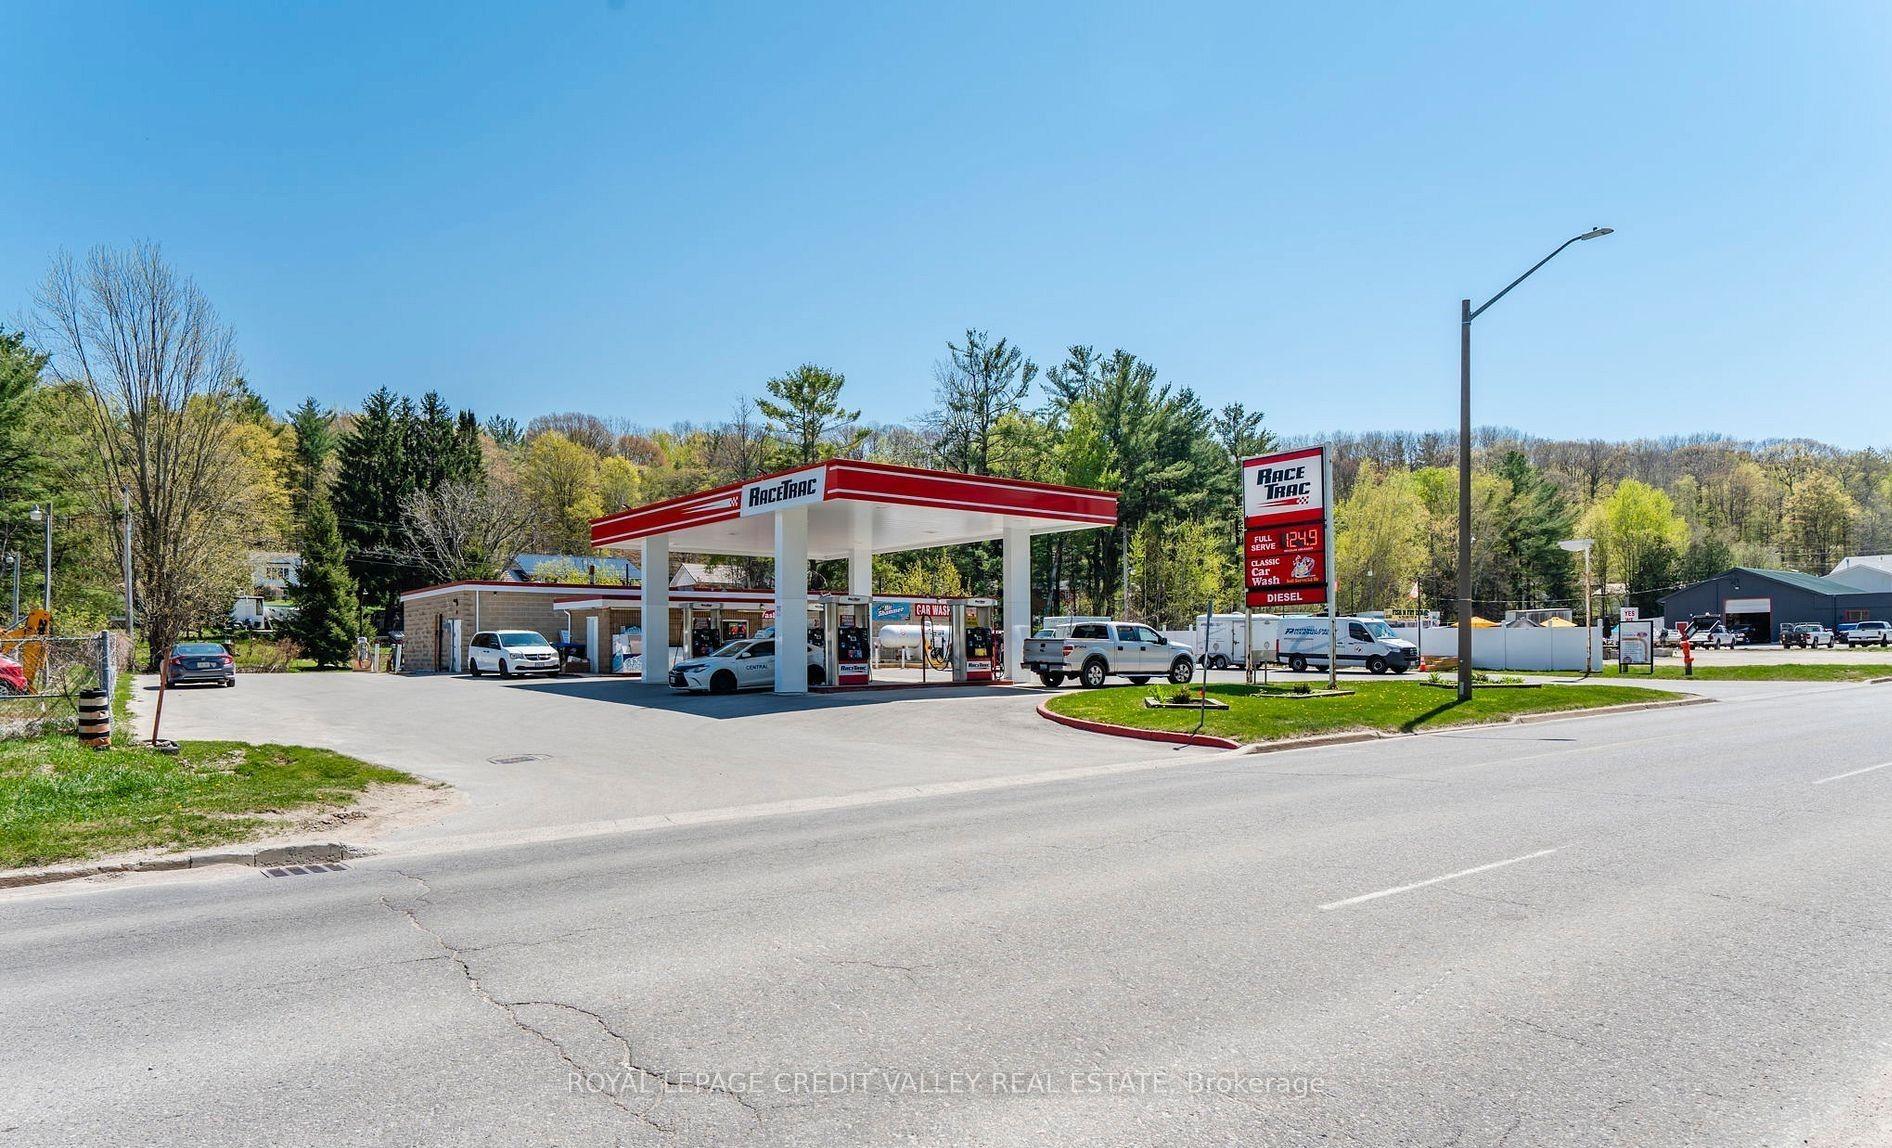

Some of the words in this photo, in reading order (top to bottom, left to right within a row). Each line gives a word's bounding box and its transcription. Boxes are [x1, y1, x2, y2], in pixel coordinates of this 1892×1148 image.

[1256, 465, 1305, 485] RACE
[1264, 481, 1310, 500] TRAC
[1254, 535, 1272, 543] FULL
[1285, 529, 1318, 548] 124.9
[1251, 543, 1276, 552] SERVE
[1251, 557, 1280, 567] CLASSIC
[1251, 567, 1270, 577] Car
[1252, 575, 1281, 586] Wash
[1267, 592, 1303, 603] DIESEL
[916, 604, 931, 616] CAR
